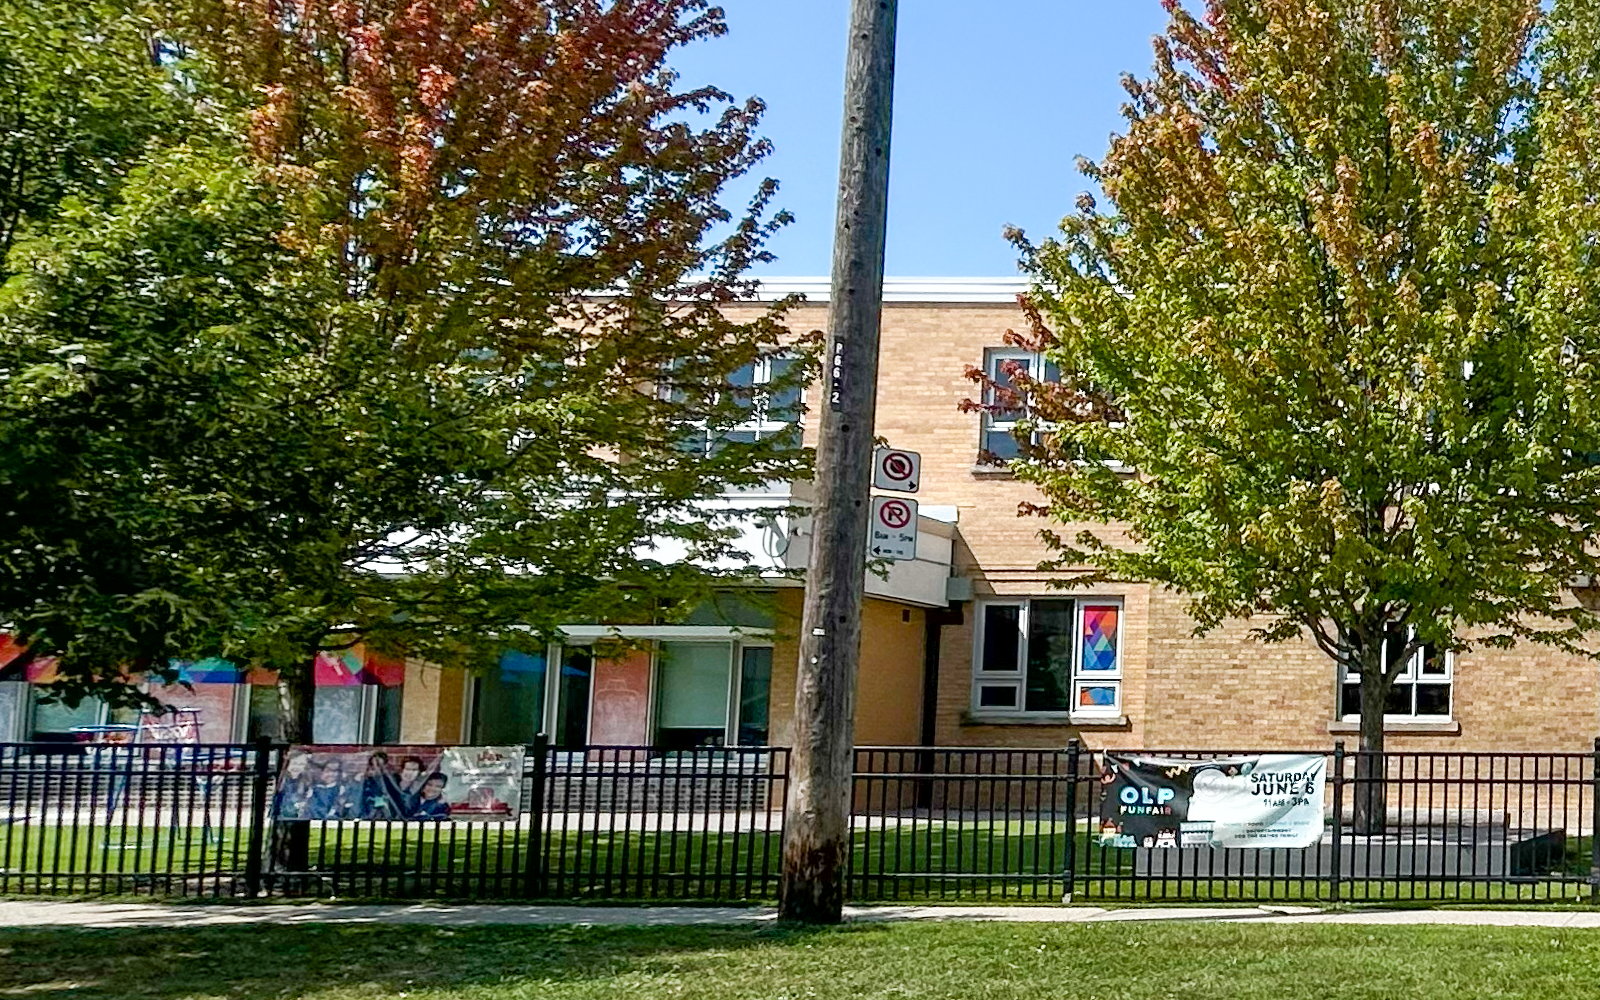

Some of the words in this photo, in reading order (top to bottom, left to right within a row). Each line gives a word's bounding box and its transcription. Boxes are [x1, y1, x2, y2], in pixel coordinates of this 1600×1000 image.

[1120, 786, 1175, 805] OLP
[1251, 783, 1300, 796] JUNE
[1305, 781, 1315, 795] 6
[1120, 805, 1172, 816] FUNFAIR
